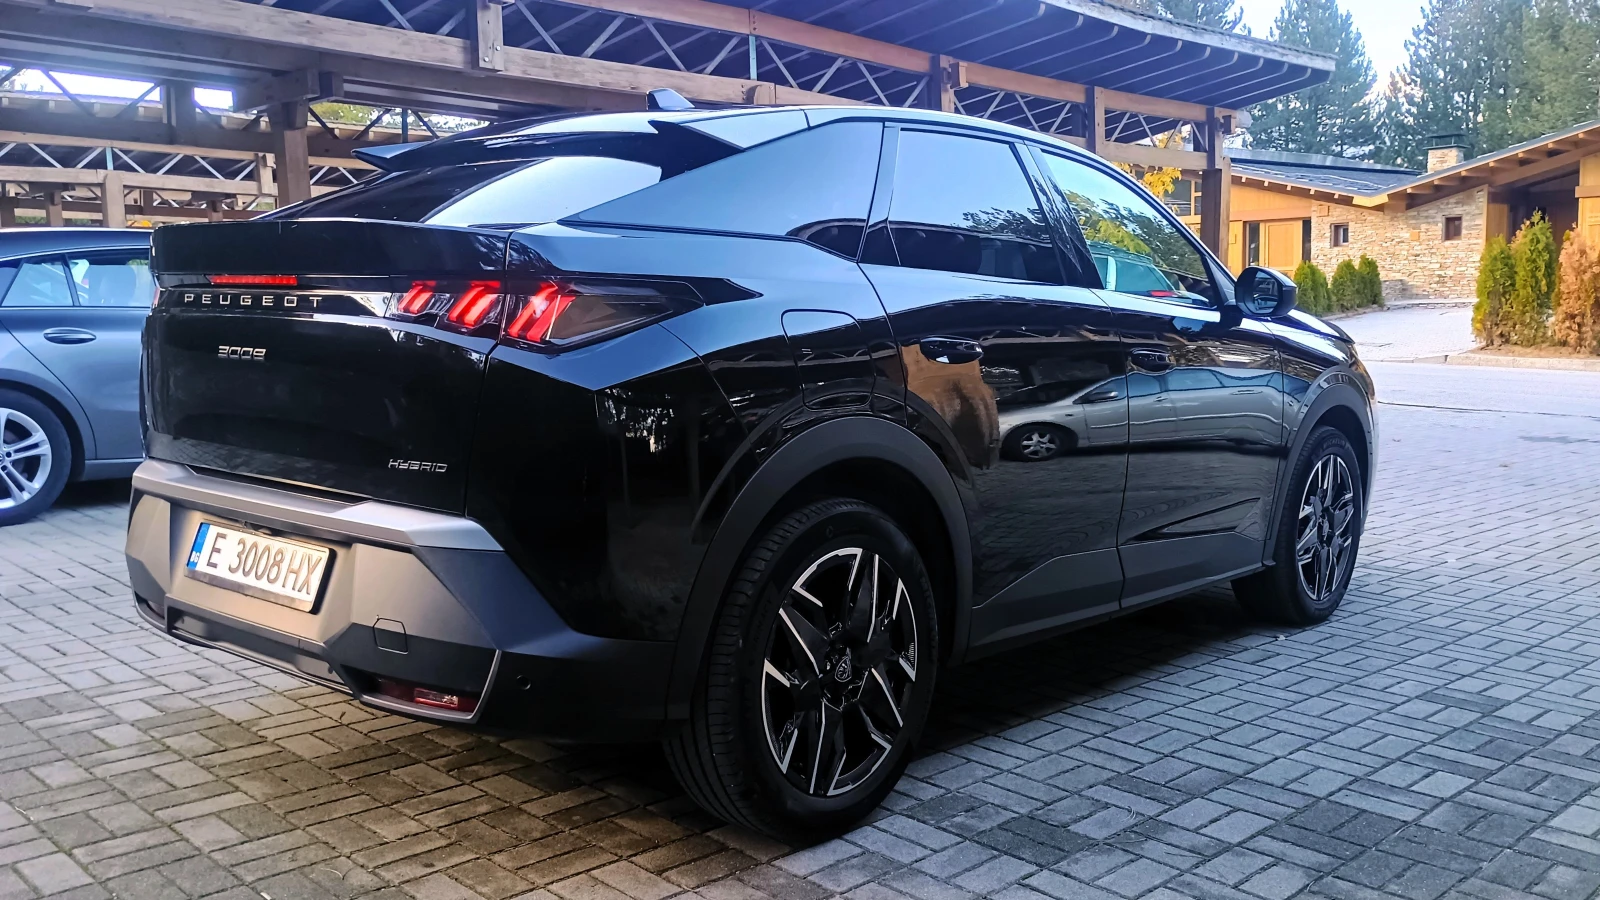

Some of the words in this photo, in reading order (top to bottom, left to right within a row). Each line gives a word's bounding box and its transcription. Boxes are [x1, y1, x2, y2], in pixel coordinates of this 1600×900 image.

[184, 293, 322, 308] PEUGEOT
[217, 345, 266, 360] 3008
[388, 458, 448, 472] HYBRID
[190, 551, 200, 562] BG
[206, 531, 228, 569] E
